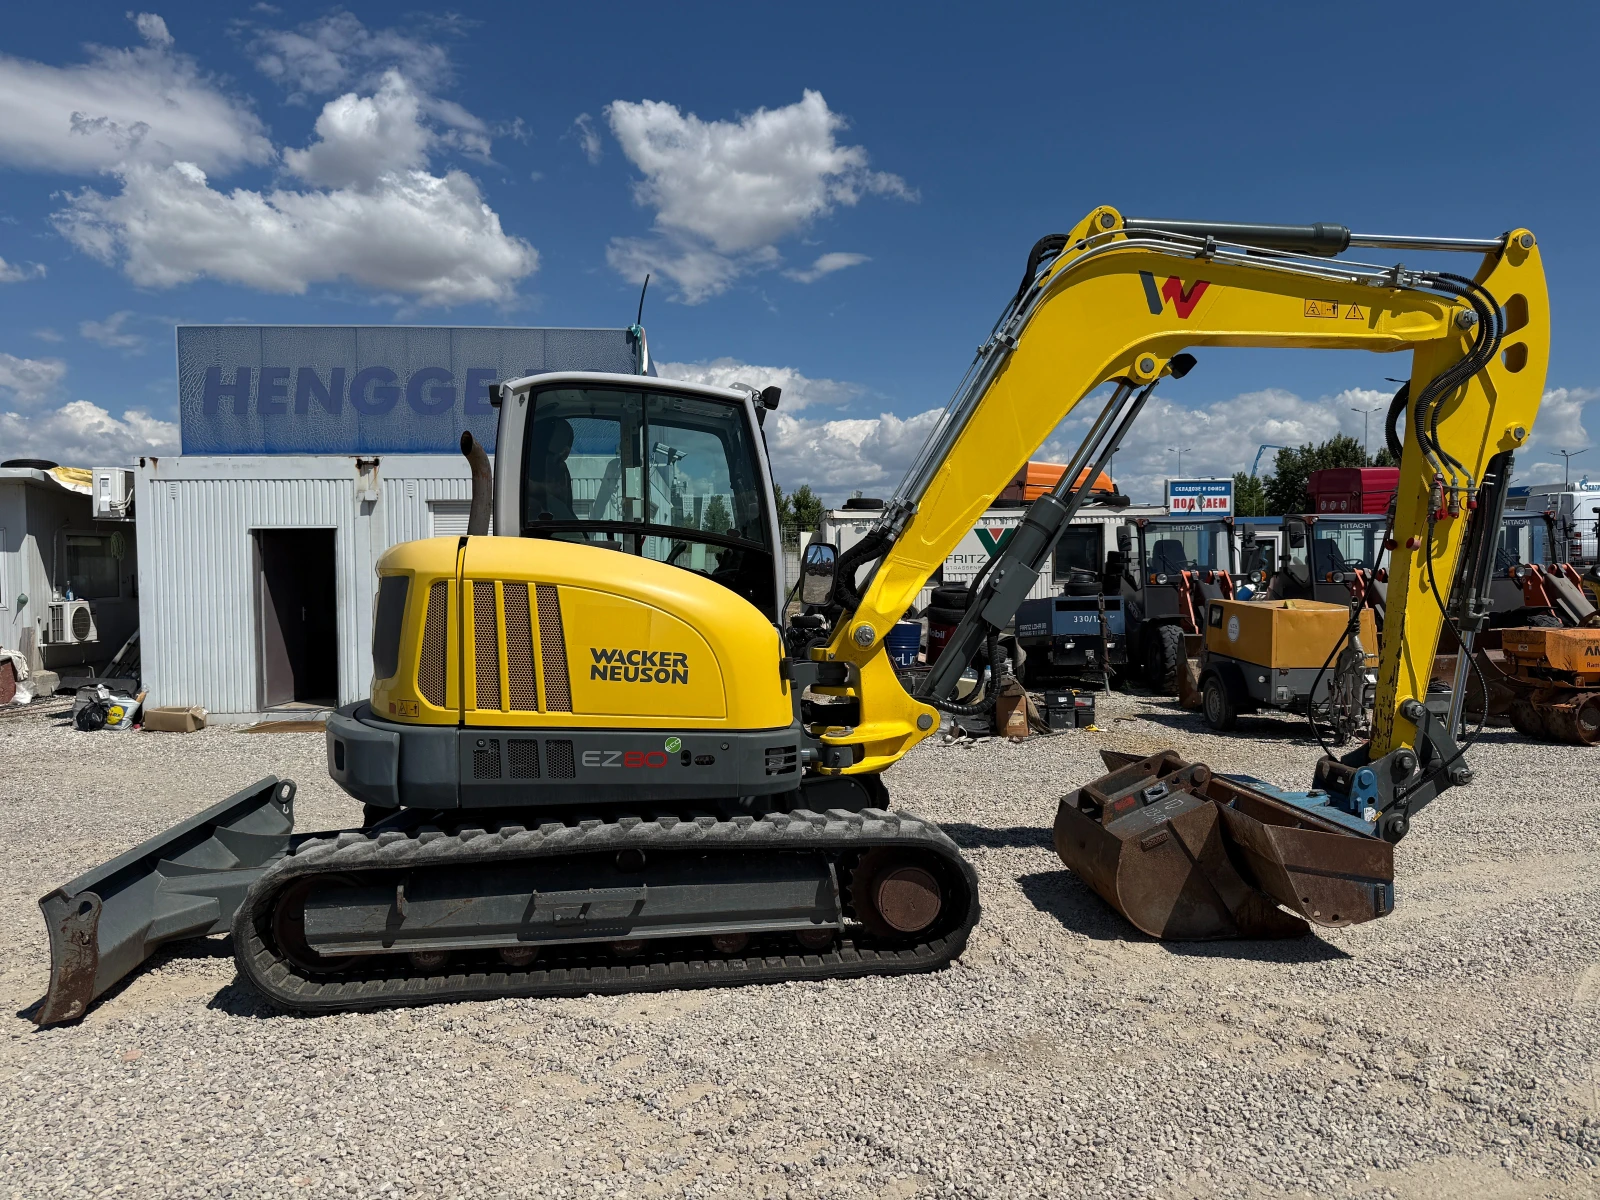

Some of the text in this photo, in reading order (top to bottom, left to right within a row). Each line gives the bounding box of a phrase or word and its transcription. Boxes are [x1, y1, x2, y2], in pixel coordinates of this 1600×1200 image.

[945, 554, 987, 564] FRITZ
[590, 648, 688, 668] WACKER
[590, 665, 688, 684] NEUSON
[582, 751, 667, 768] EZ80
